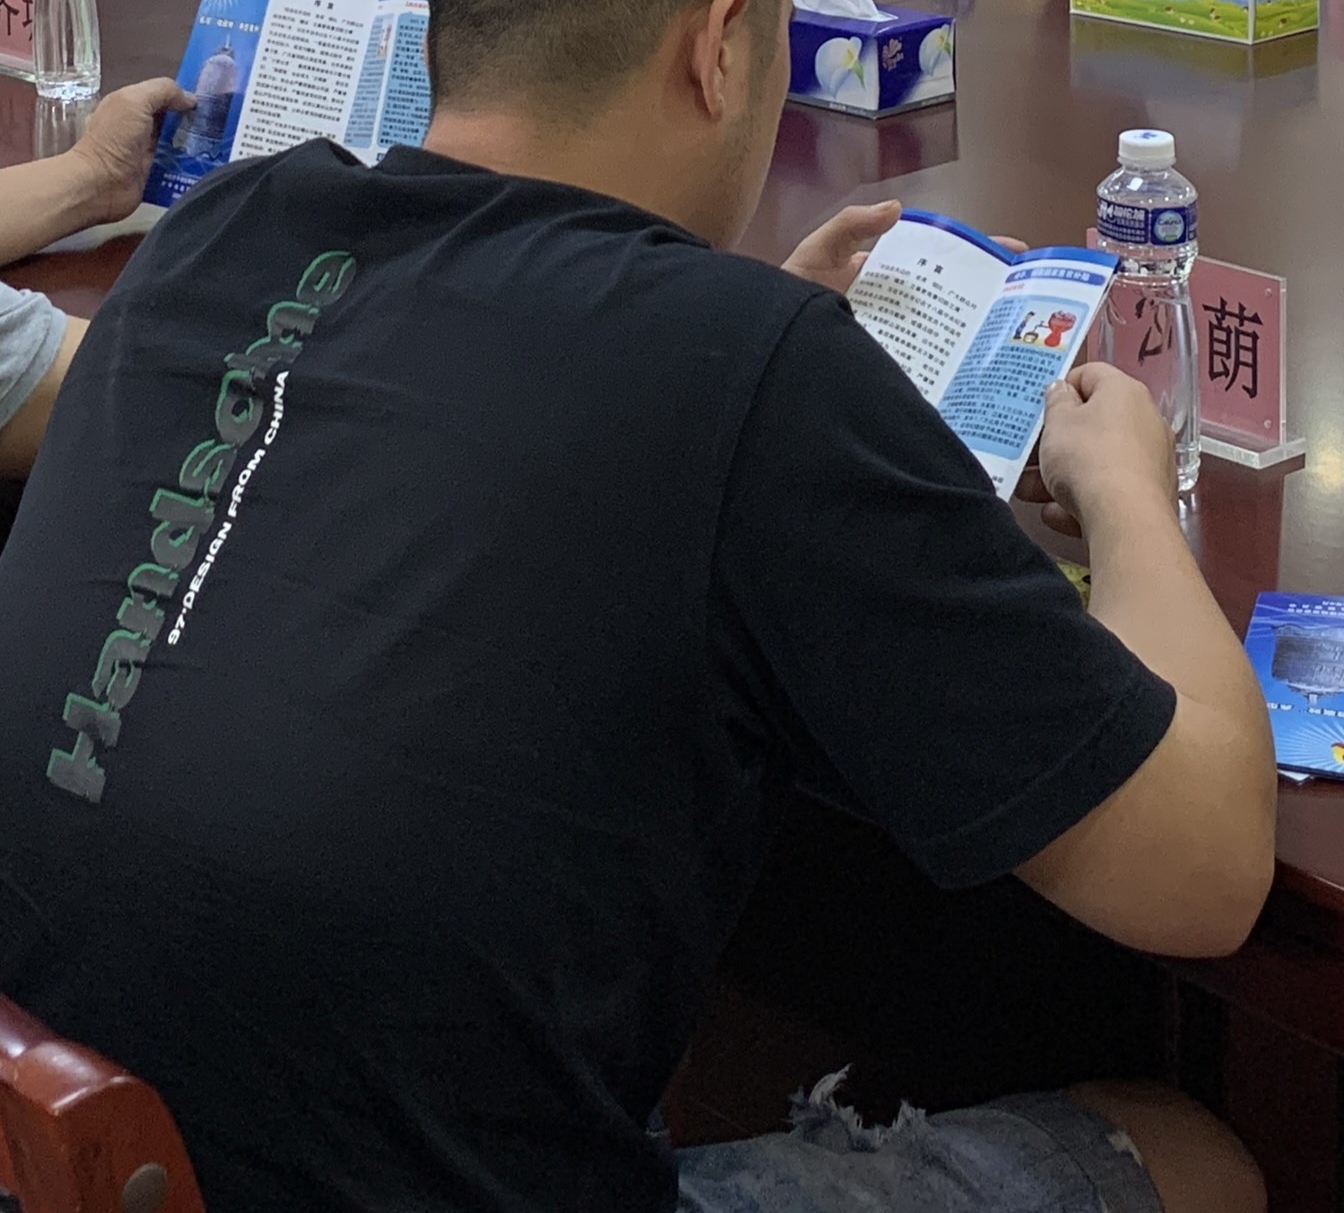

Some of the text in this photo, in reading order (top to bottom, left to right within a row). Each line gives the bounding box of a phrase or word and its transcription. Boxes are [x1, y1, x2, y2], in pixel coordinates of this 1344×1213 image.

[47, 250, 356, 803] Handsome
[228, 448, 266, 518] FROM
[264, 371, 290, 447] CHINA
